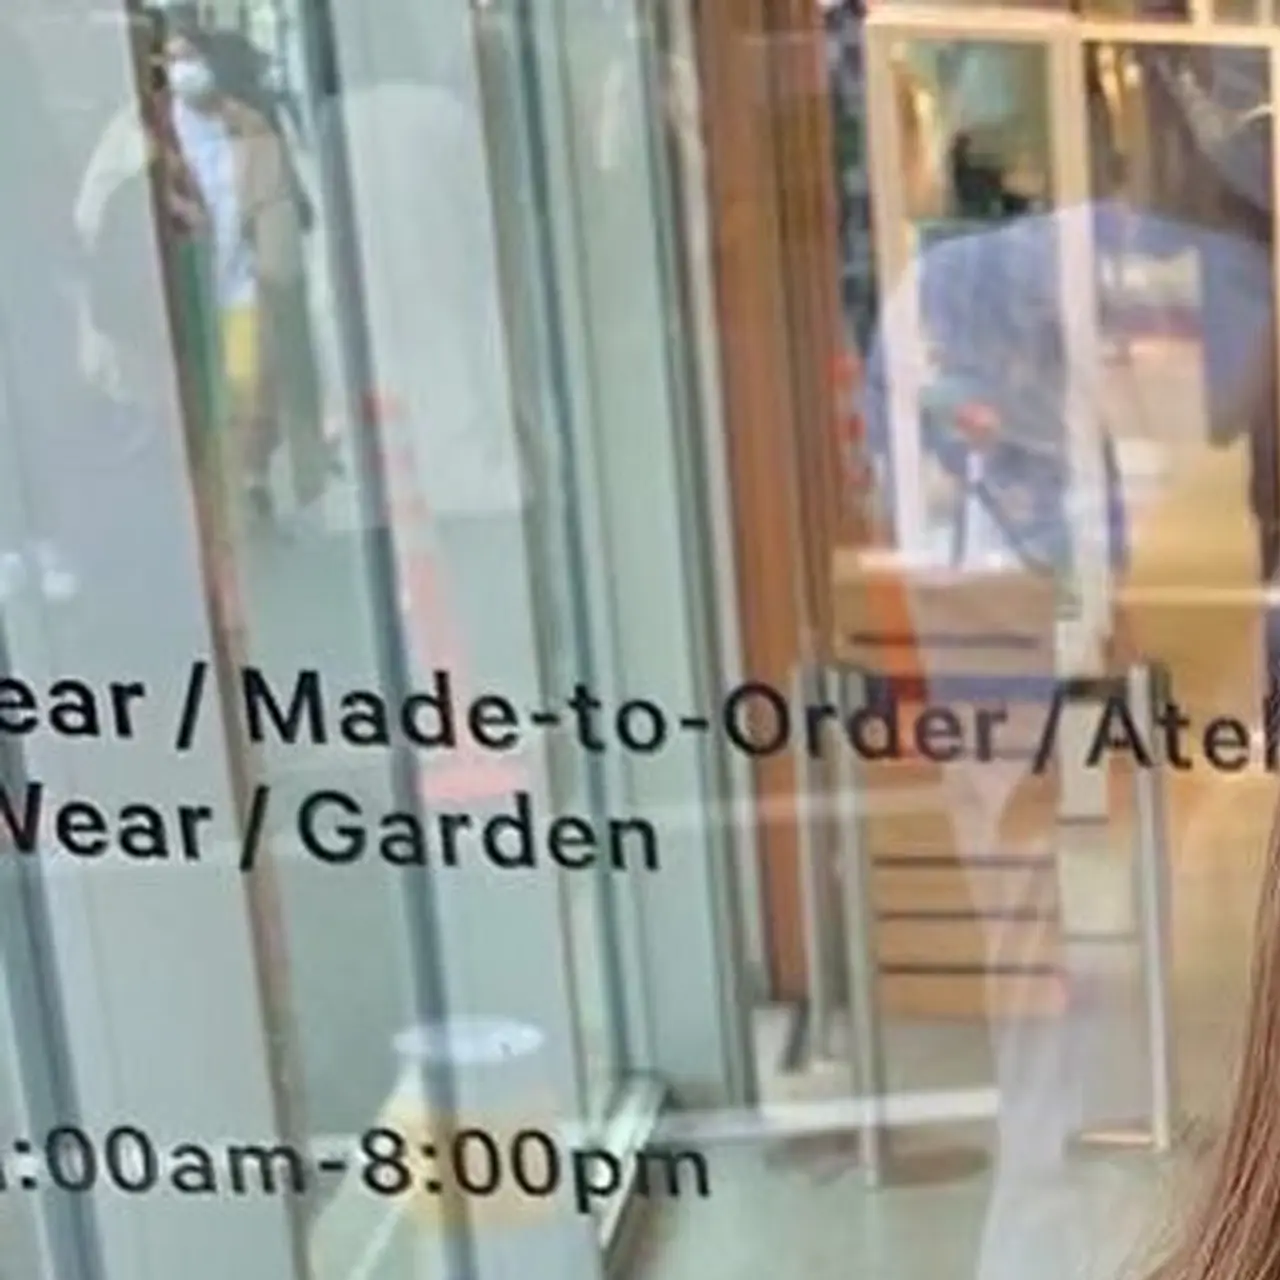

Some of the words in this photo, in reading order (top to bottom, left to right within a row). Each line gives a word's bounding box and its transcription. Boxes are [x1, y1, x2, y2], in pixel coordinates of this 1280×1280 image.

[241, 667, 1007, 764] Made-to-Order
[297, 788, 661, 872] Garden
[0, 1124, 712, 1214] :00am-8:00pm
